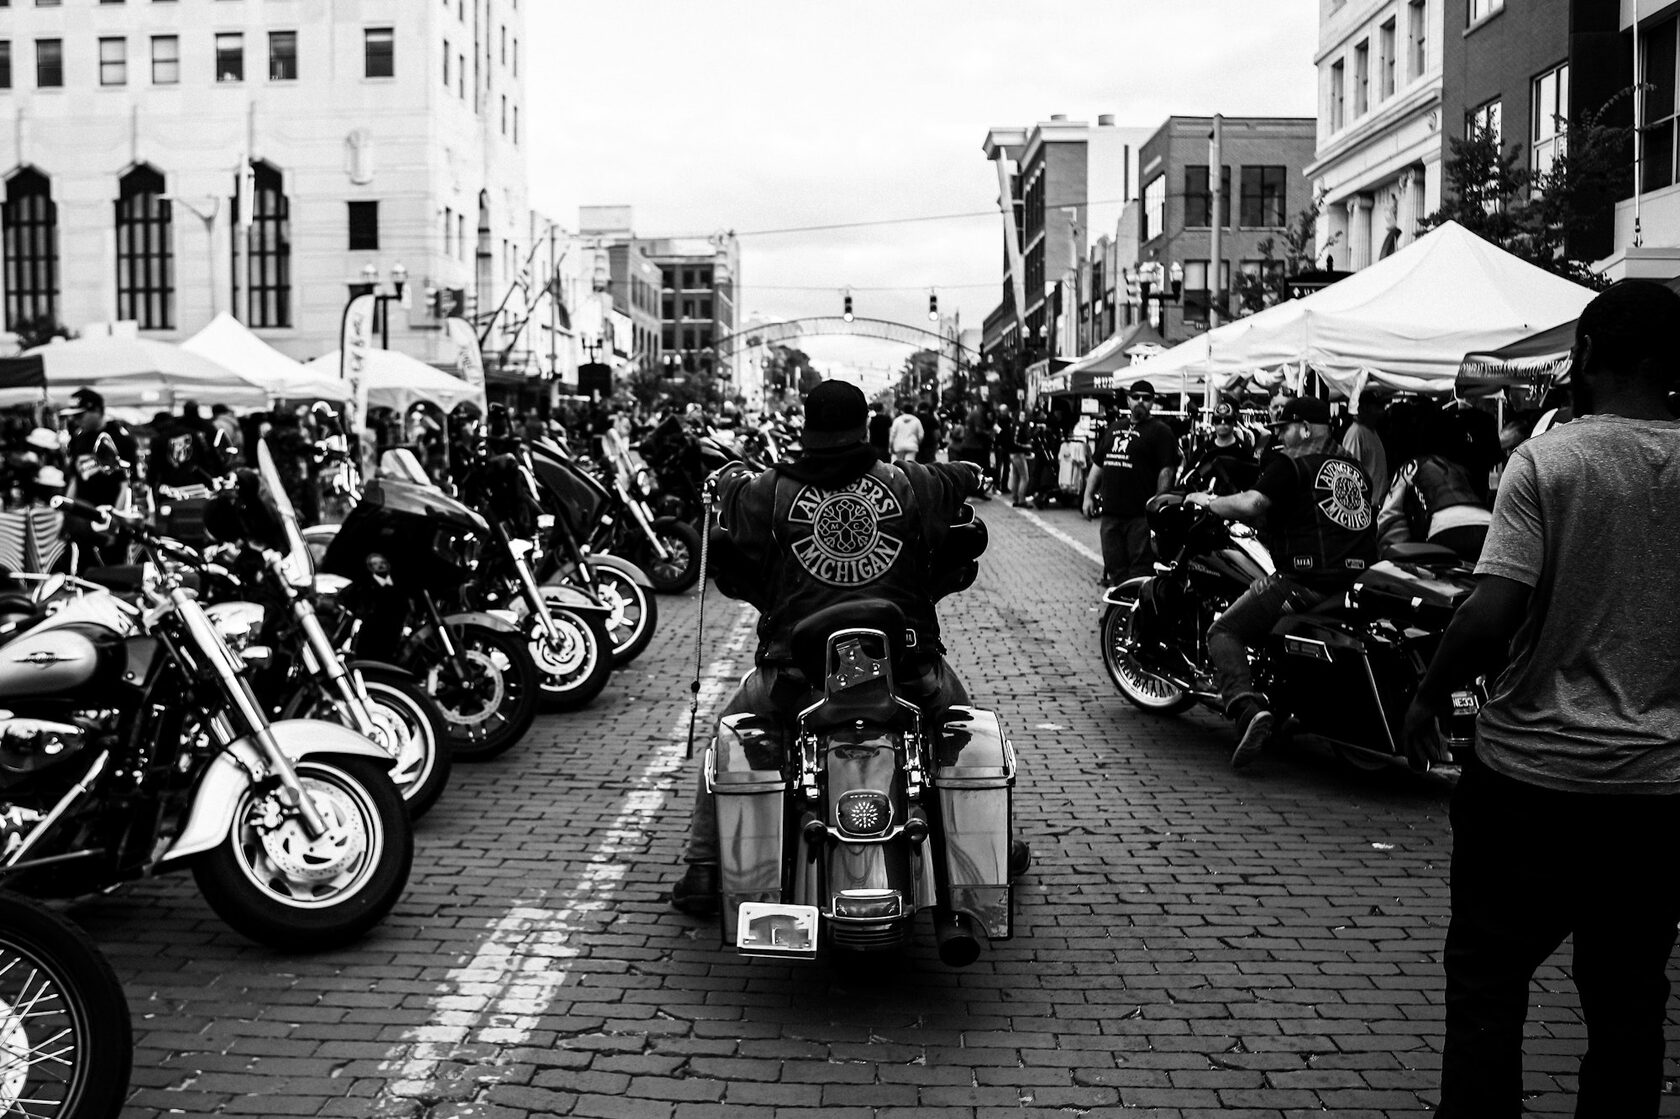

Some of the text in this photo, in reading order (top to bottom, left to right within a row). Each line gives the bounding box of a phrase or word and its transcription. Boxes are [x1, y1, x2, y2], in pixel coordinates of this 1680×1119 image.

[797, 477, 895, 519] AVGERS
[1325, 502, 1370, 528] MICHIGAN
[800, 540, 896, 582] MICHIGAN
